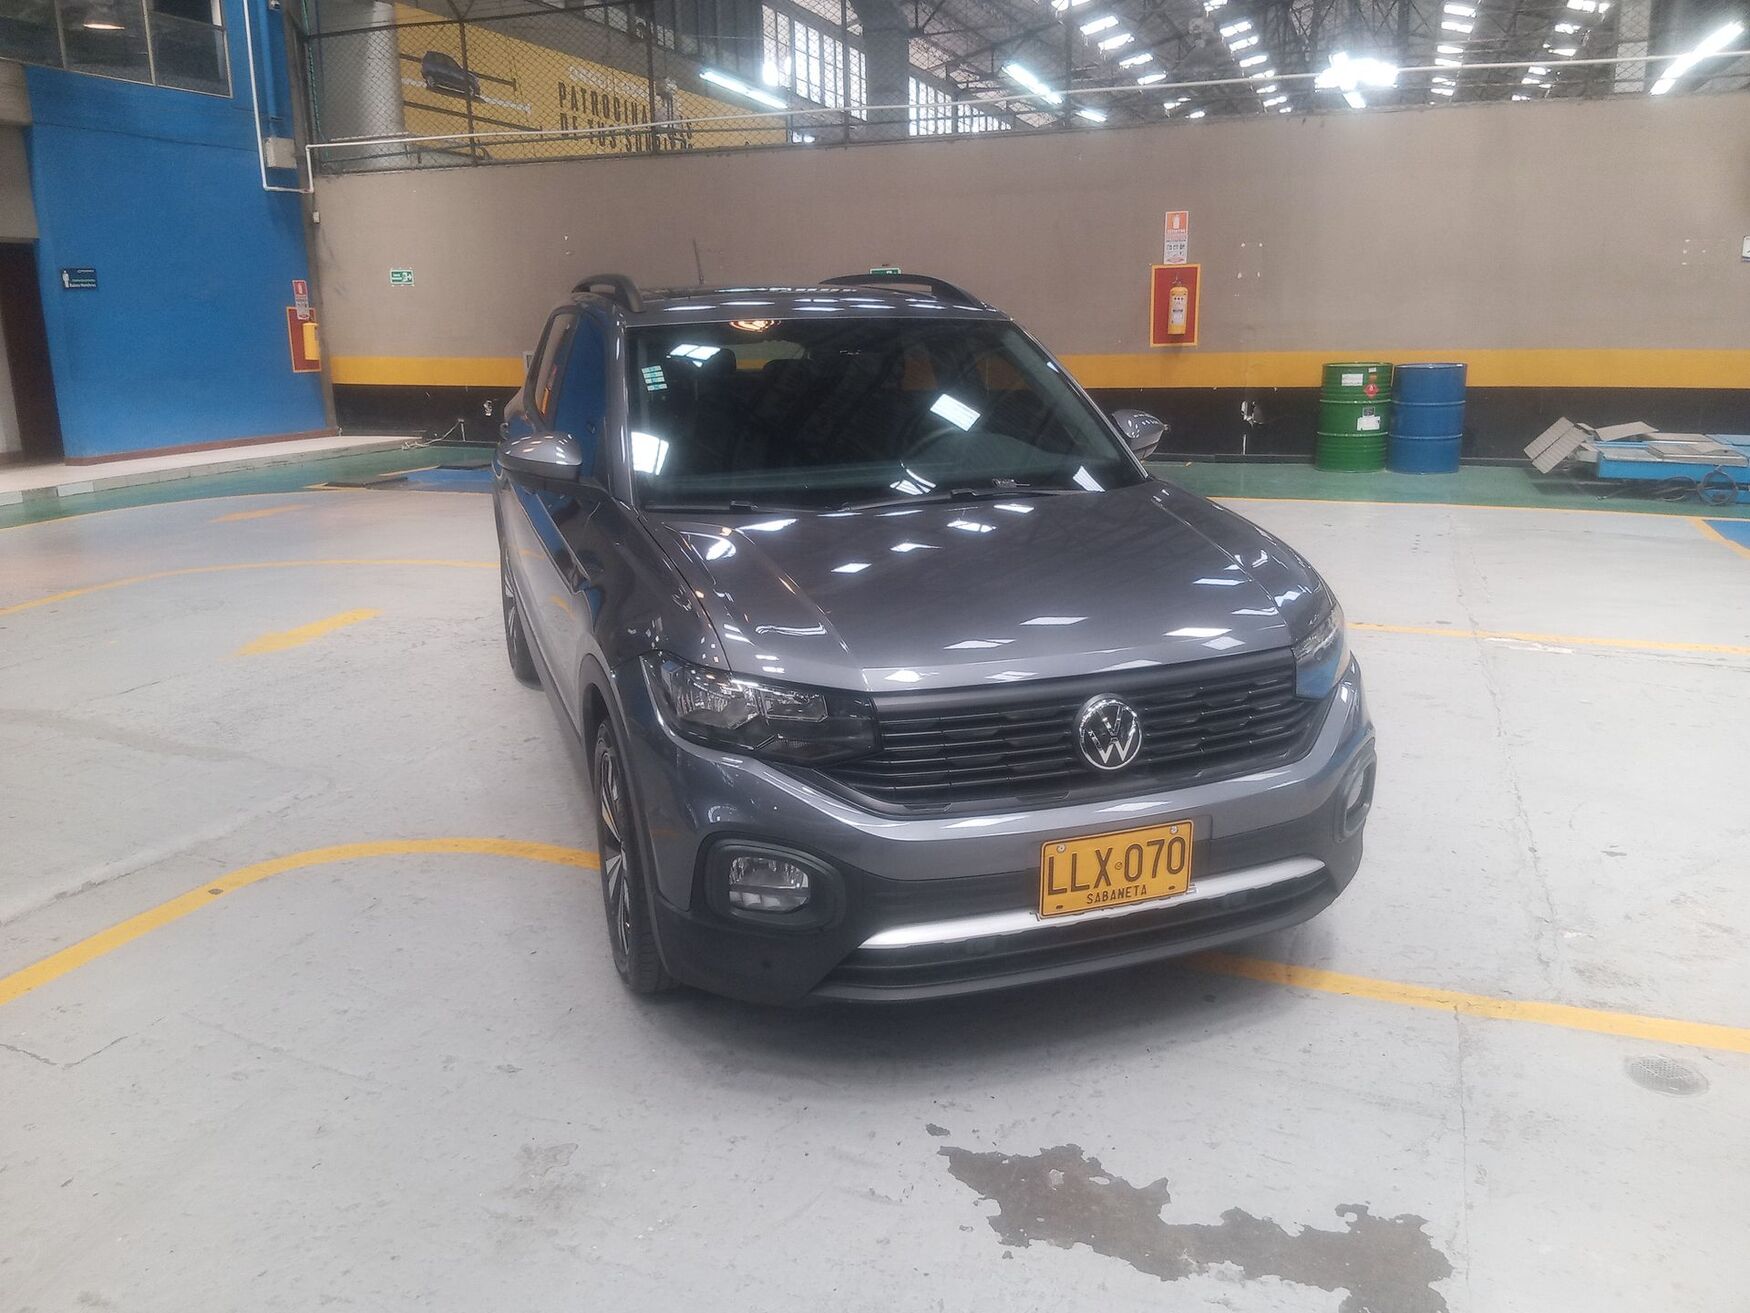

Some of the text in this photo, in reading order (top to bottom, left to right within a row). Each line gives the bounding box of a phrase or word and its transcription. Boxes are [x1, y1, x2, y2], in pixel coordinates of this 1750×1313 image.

[1047, 836, 1186, 896] LLX 070
[1086, 884, 1147, 904] SABANETA
